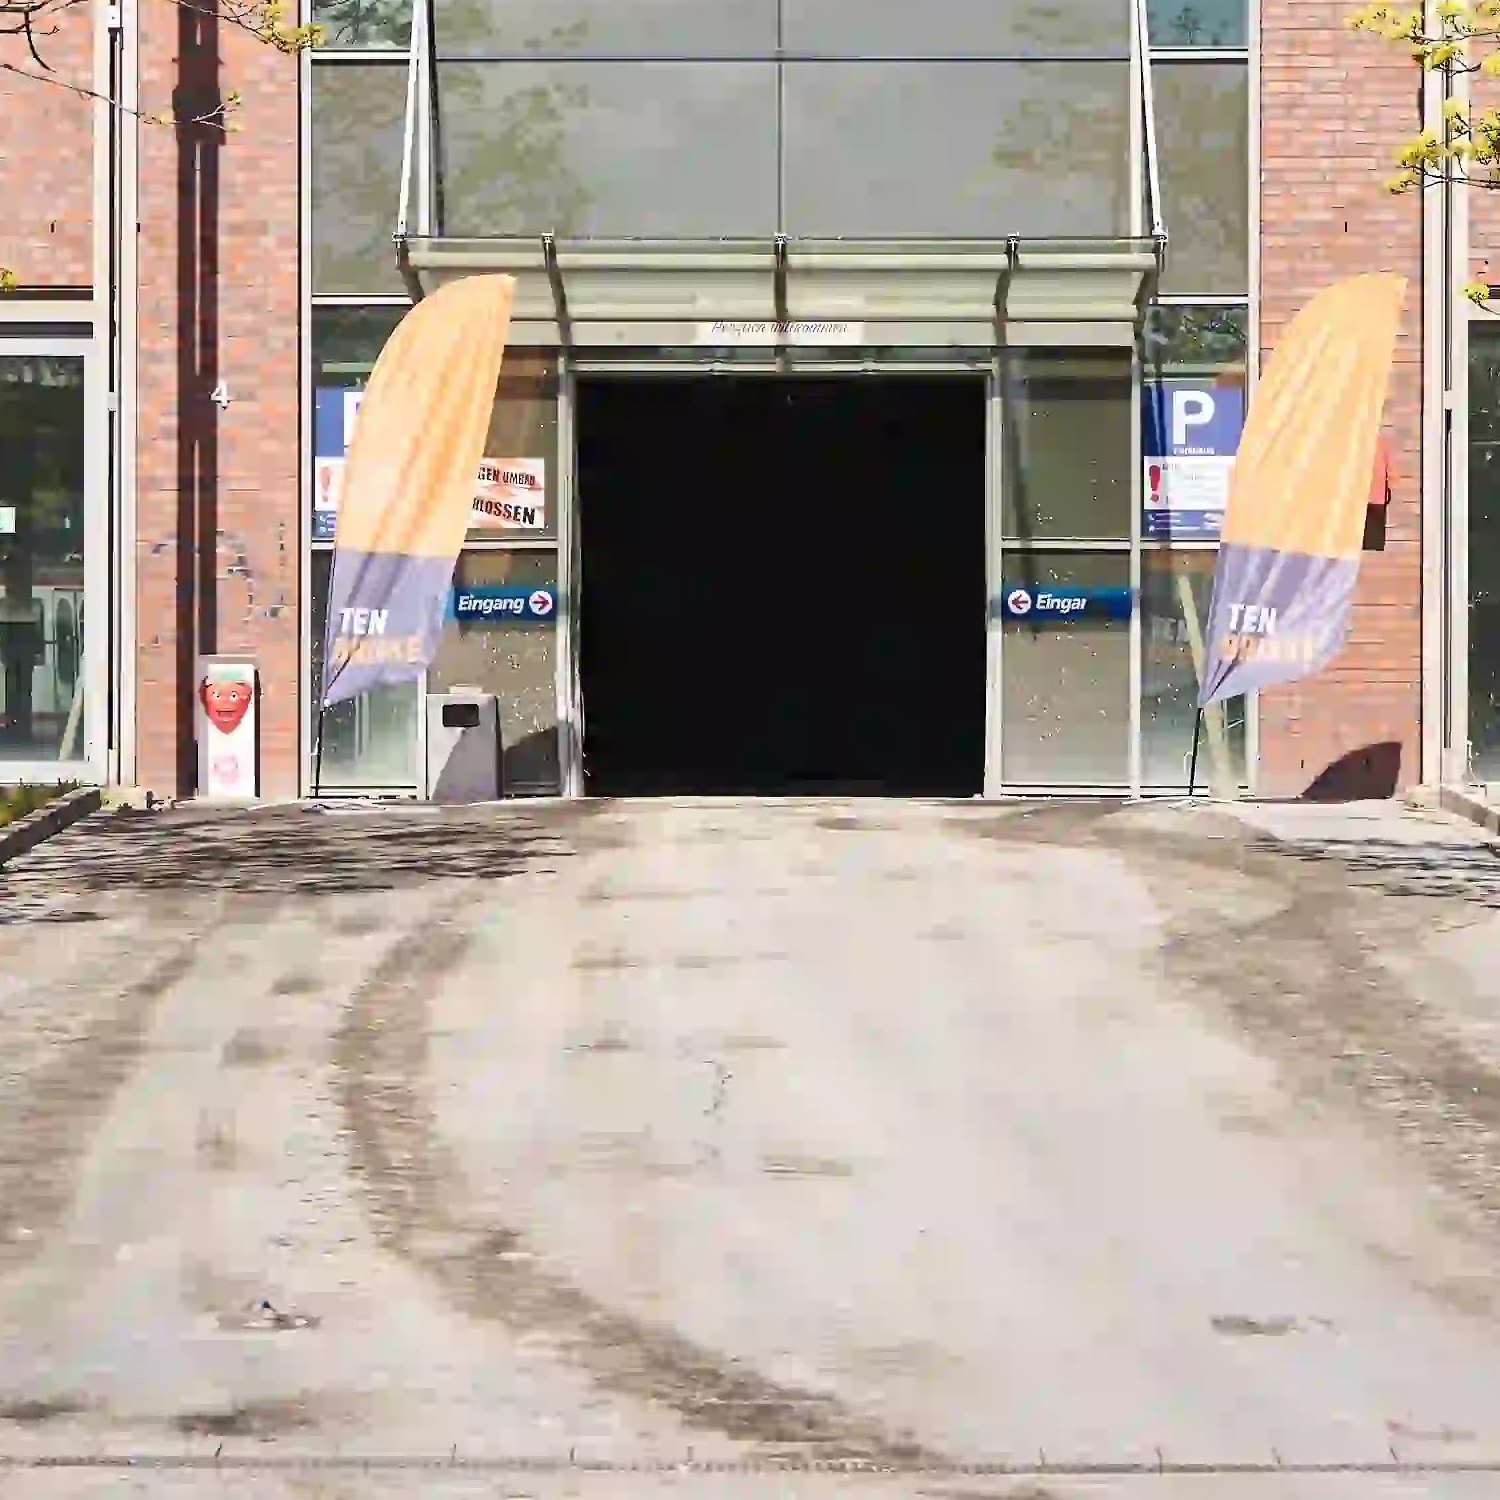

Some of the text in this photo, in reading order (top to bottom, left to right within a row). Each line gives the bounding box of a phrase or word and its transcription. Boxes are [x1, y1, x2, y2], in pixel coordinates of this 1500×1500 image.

[210, 380, 230, 407] 4
[1172, 390, 1216, 445] P
[457, 594, 525, 614] Eingang
[1228, 603, 1277, 633] TEN
[338, 607, 389, 636] TEN
